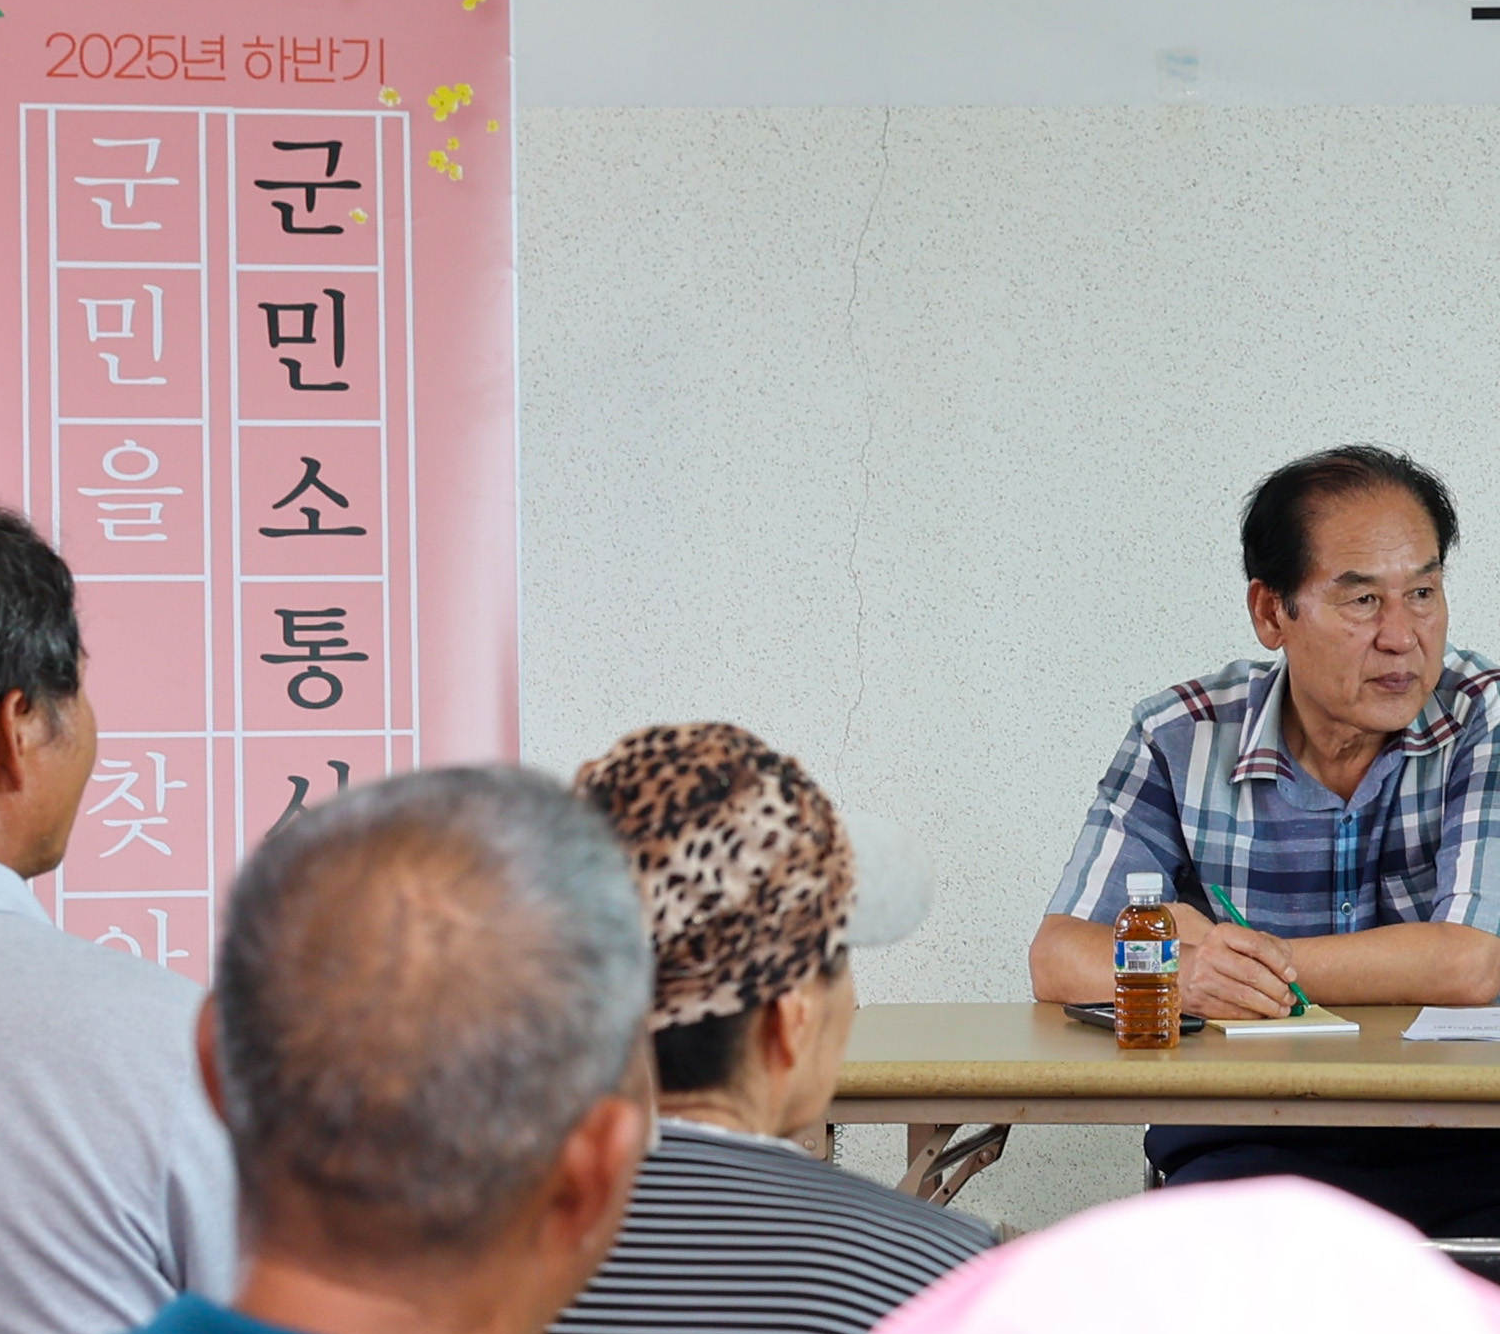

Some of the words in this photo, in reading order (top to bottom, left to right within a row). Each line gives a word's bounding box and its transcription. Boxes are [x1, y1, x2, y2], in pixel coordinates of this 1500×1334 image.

[45, 31, 228, 83] 2025년
[243, 35, 387, 85] 하반기
[73, 137, 186, 543] 군민을
